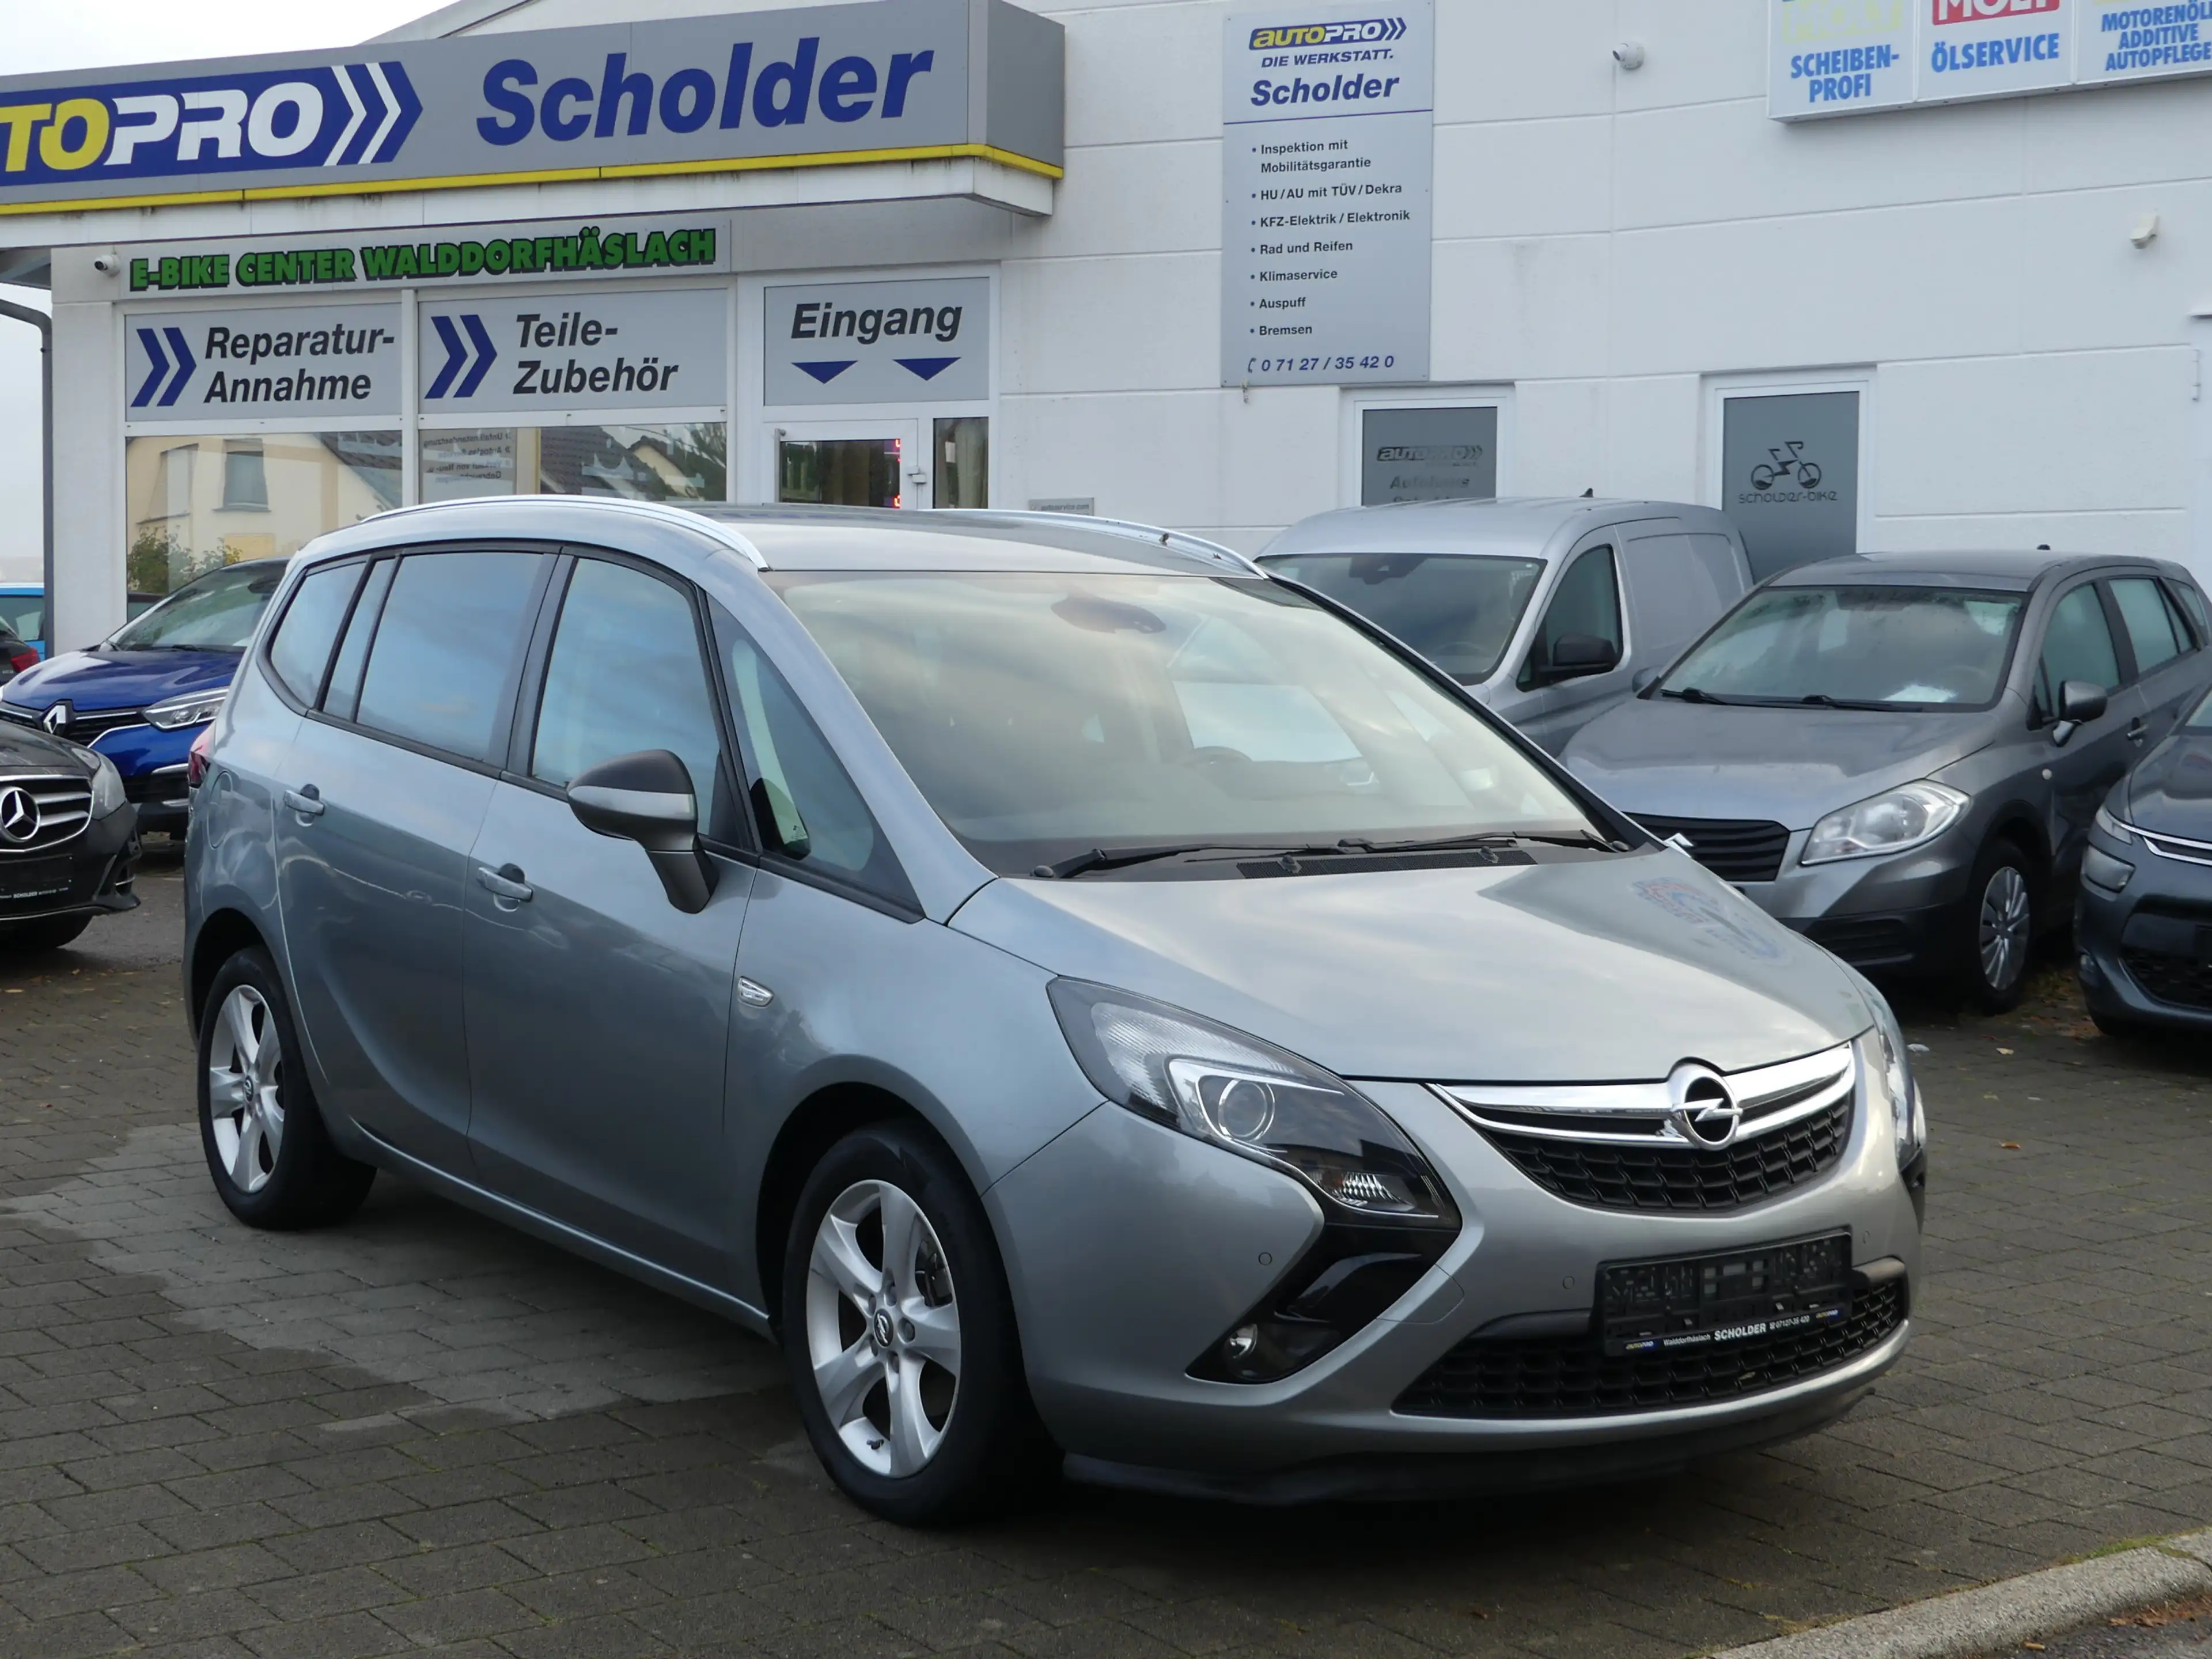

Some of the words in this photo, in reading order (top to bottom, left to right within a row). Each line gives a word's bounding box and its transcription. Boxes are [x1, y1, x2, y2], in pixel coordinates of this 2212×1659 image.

[2101, 0, 2212, 32] MOTORENÖL
[2119, 24, 2198, 49] ADDITIVE
[1261, 56, 1288, 68] DIE
[1294, 49, 1393, 65] WERKSTATT.
[1791, 44, 1899, 78] SCHEIBEN-
[1931, 33, 2059, 73] ÖLSERVICE
[2105, 42, 2211, 71] AUTOPFLEGE
[476, 37, 934, 145] Scholder
[1251, 74, 1400, 106] Scholder
[1809, 74, 1870, 102] PROFI
[1261, 142, 1324, 156] Inspektion
[1328, 140, 1348, 150] mit
[1261, 157, 1371, 173] Mobilitätsgarantie
[1308, 186, 1327, 198] mit
[130, 254, 230, 291] E-BIKE
[236, 249, 355, 286] CENTER
[359, 227, 715, 281] WALDDORFHÄSLACH
[1260, 244, 1282, 255] Rad
[1287, 243, 1309, 253] und
[1314, 241, 1353, 252] Reifen
[1260, 269, 1338, 282] Klimaservice
[1259, 297, 1306, 309] Auspuff
[516, 312, 618, 348] Teile-
[791, 303, 962, 344] Eingang
[1259, 325, 1312, 336] Bremsen
[205, 324, 394, 366] Reparatur-
[513, 358, 679, 395] Zubehör
[1300, 358, 1319, 370] 27
[1335, 357, 1354, 369] 35
[204, 370, 371, 404] Annahme
[1714, 1323, 1766, 1340] SCHOLDER
